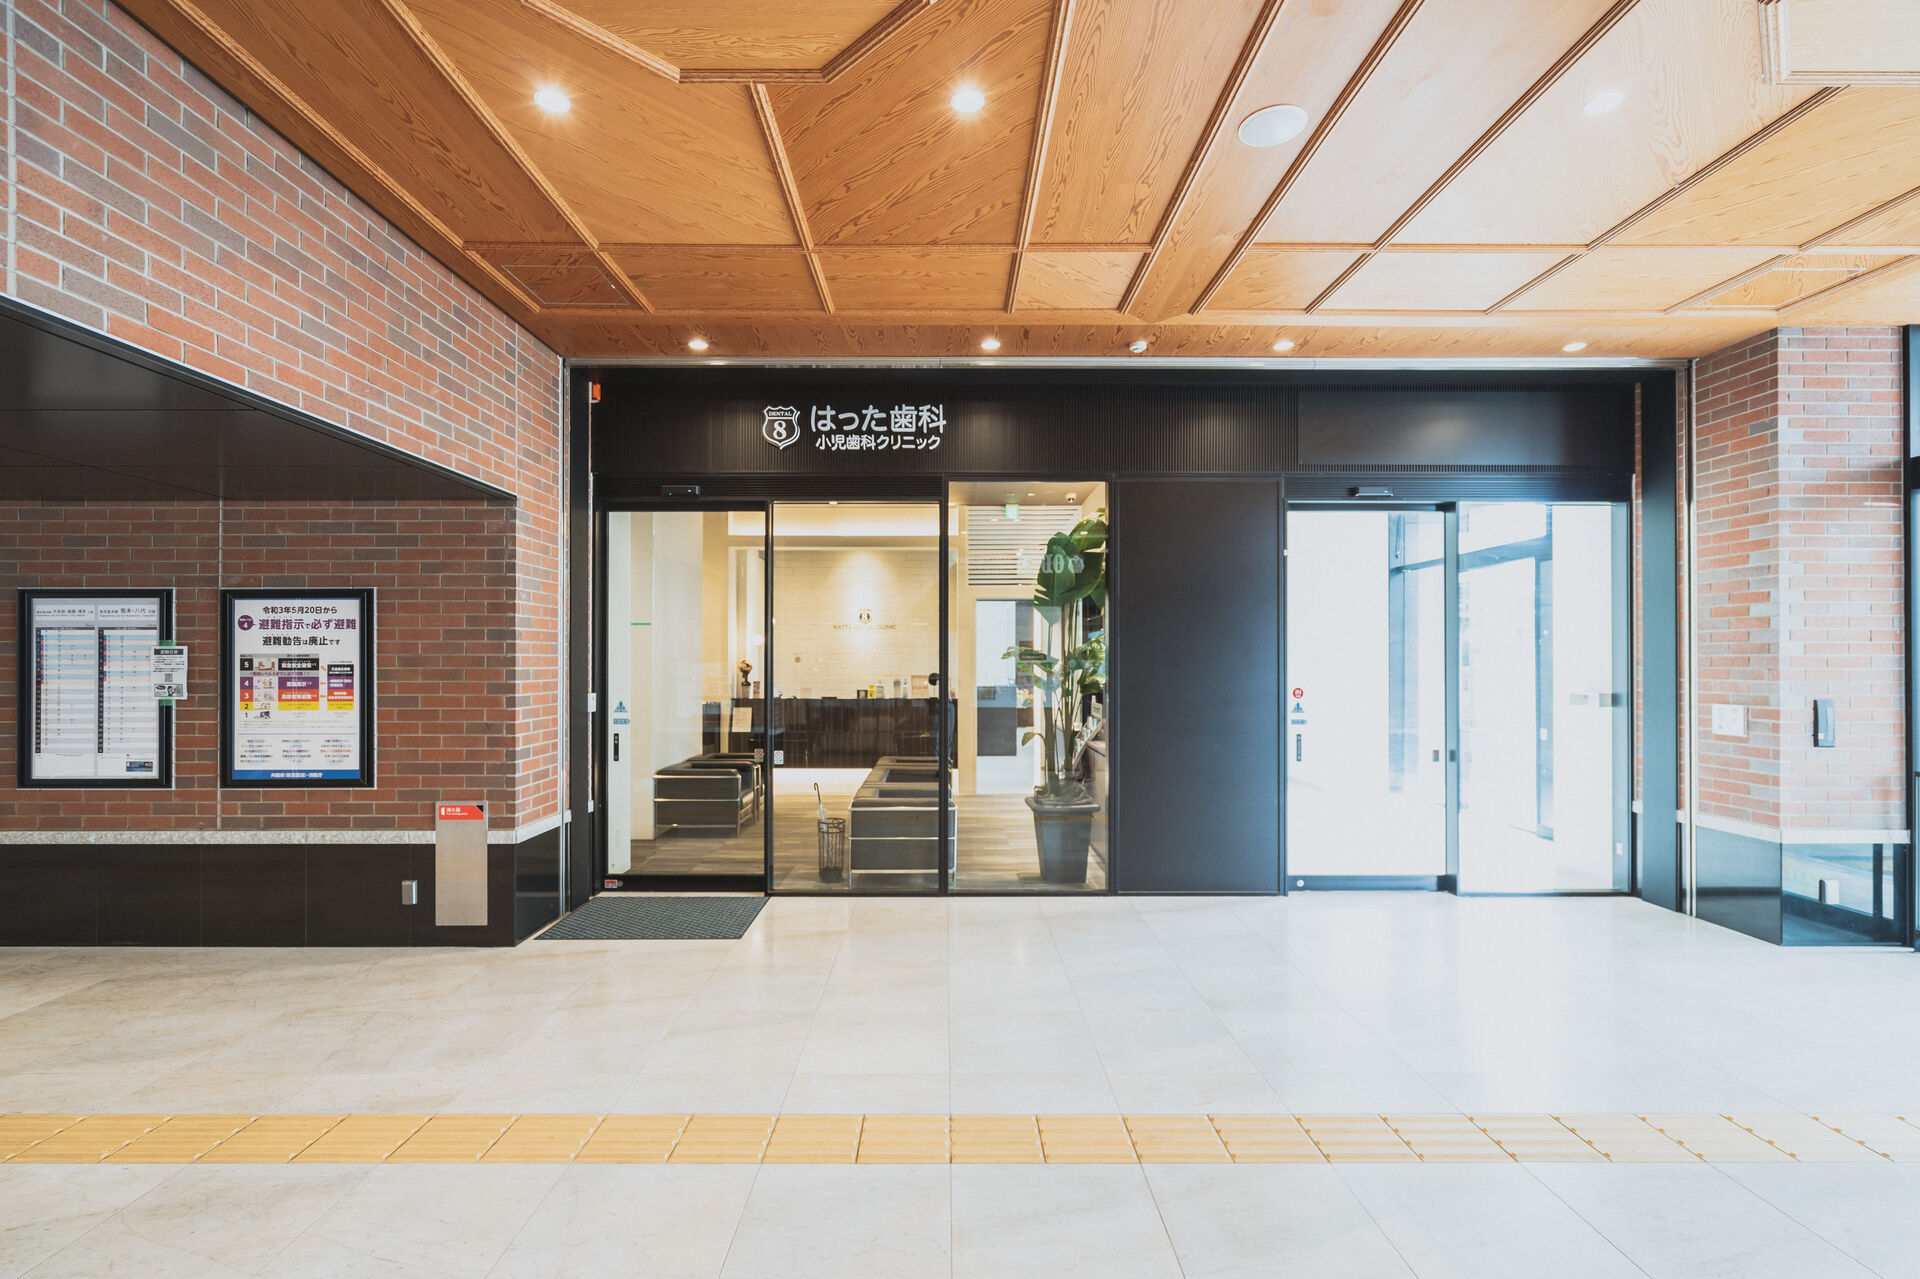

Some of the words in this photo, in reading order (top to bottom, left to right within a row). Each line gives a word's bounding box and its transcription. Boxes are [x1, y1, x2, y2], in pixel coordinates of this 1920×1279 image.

[810, 404, 947, 433] はった歯科
[772, 420, 787, 440] 8
[815, 434, 941, 451] 小児歯科クリニック
[262, 606, 338, 614] 令和3年5月20日から
[258, 618, 357, 630] 避難指示で必ず避難
[262, 635, 340, 646] 避難勧告は廃止です
